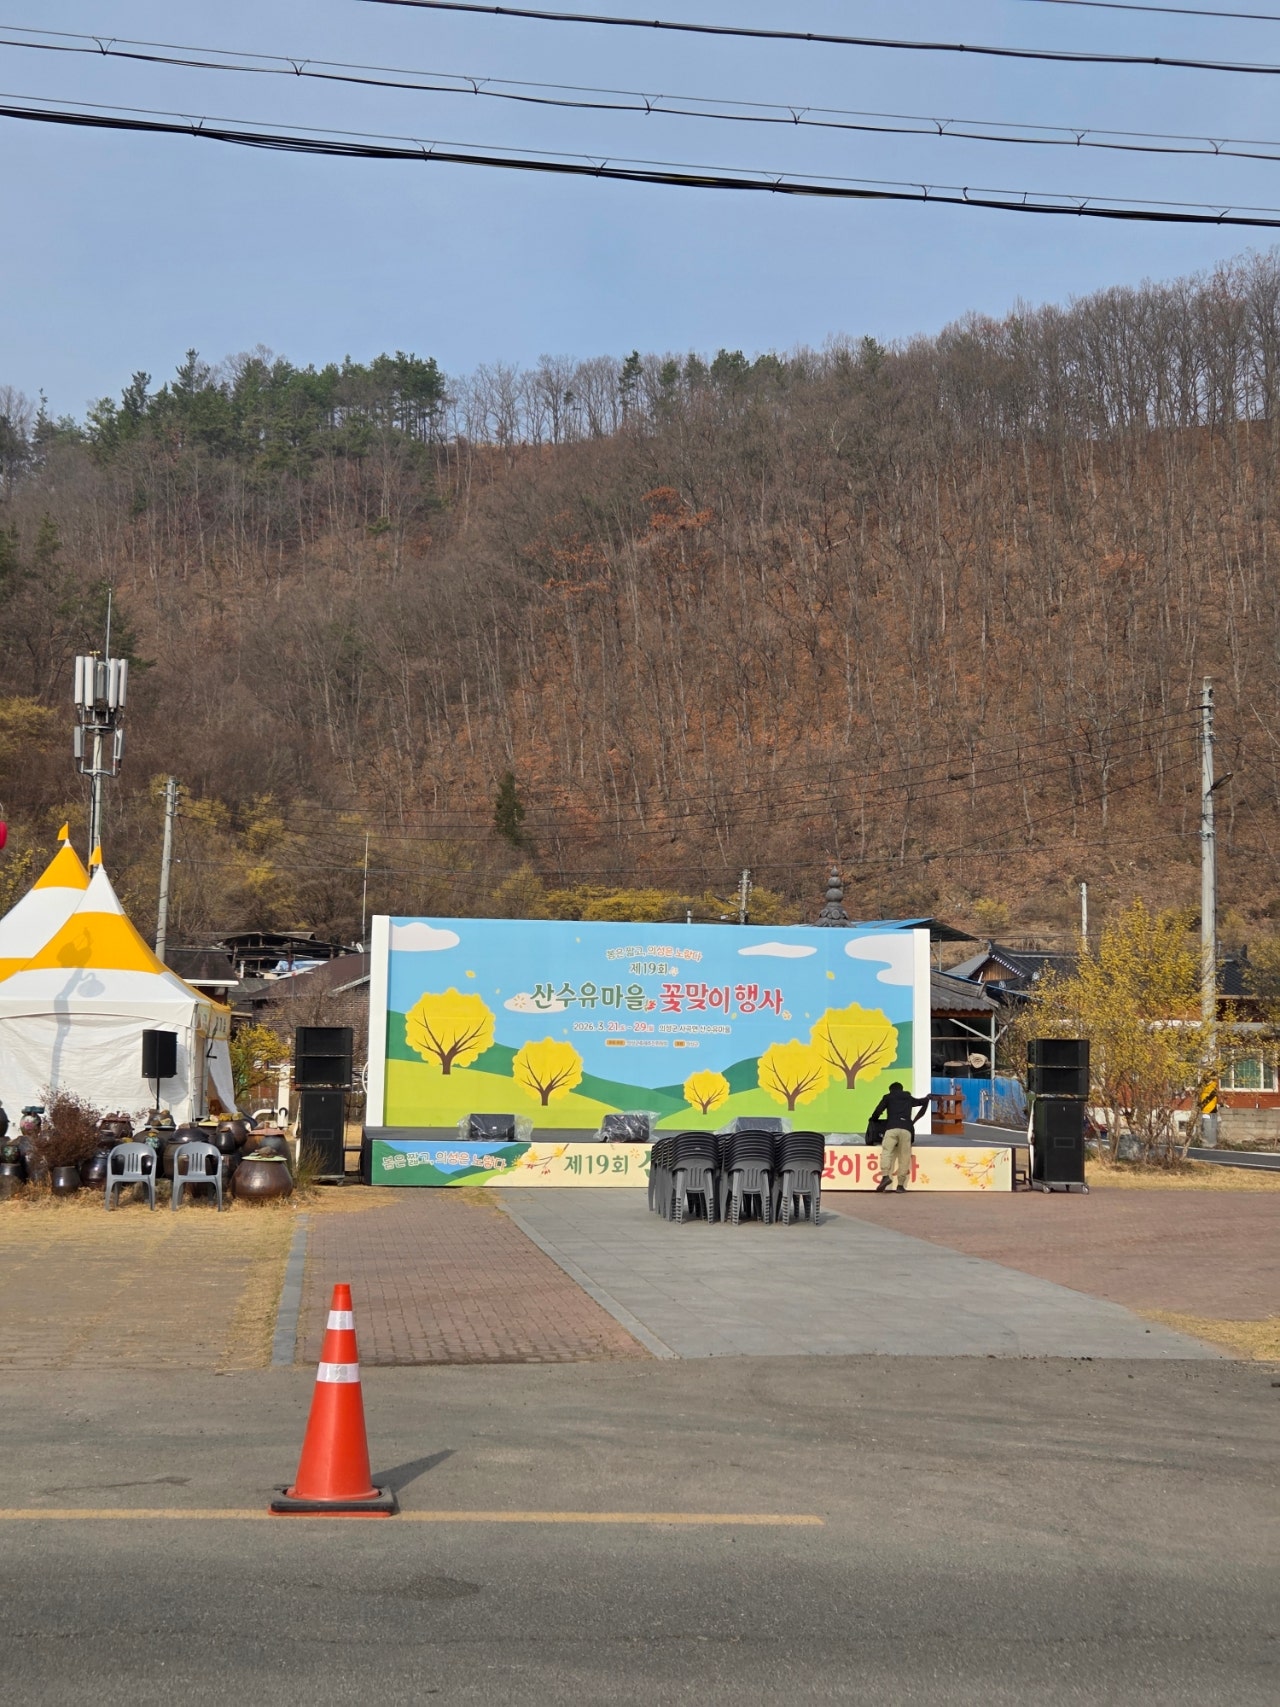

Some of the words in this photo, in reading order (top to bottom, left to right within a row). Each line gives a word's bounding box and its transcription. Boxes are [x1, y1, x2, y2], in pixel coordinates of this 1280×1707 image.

[607, 949, 623, 960] 봄은
[647, 946, 673, 957] 의성은
[630, 962, 668, 975] 제19회
[530, 983, 645, 1010] 산수유마을
[659, 983, 730, 1014] 꽃맞이
[734, 984, 783, 1015] 행사
[574, 1023, 596, 1031] 2026.
[700, 1025, 731, 1034] 산수유마을
[382, 1154, 406, 1170] 봄은
[407, 1152, 434, 1166] 짧고,
[435, 1151, 470, 1165] 의성은
[564, 1155, 629, 1175] 제19회
